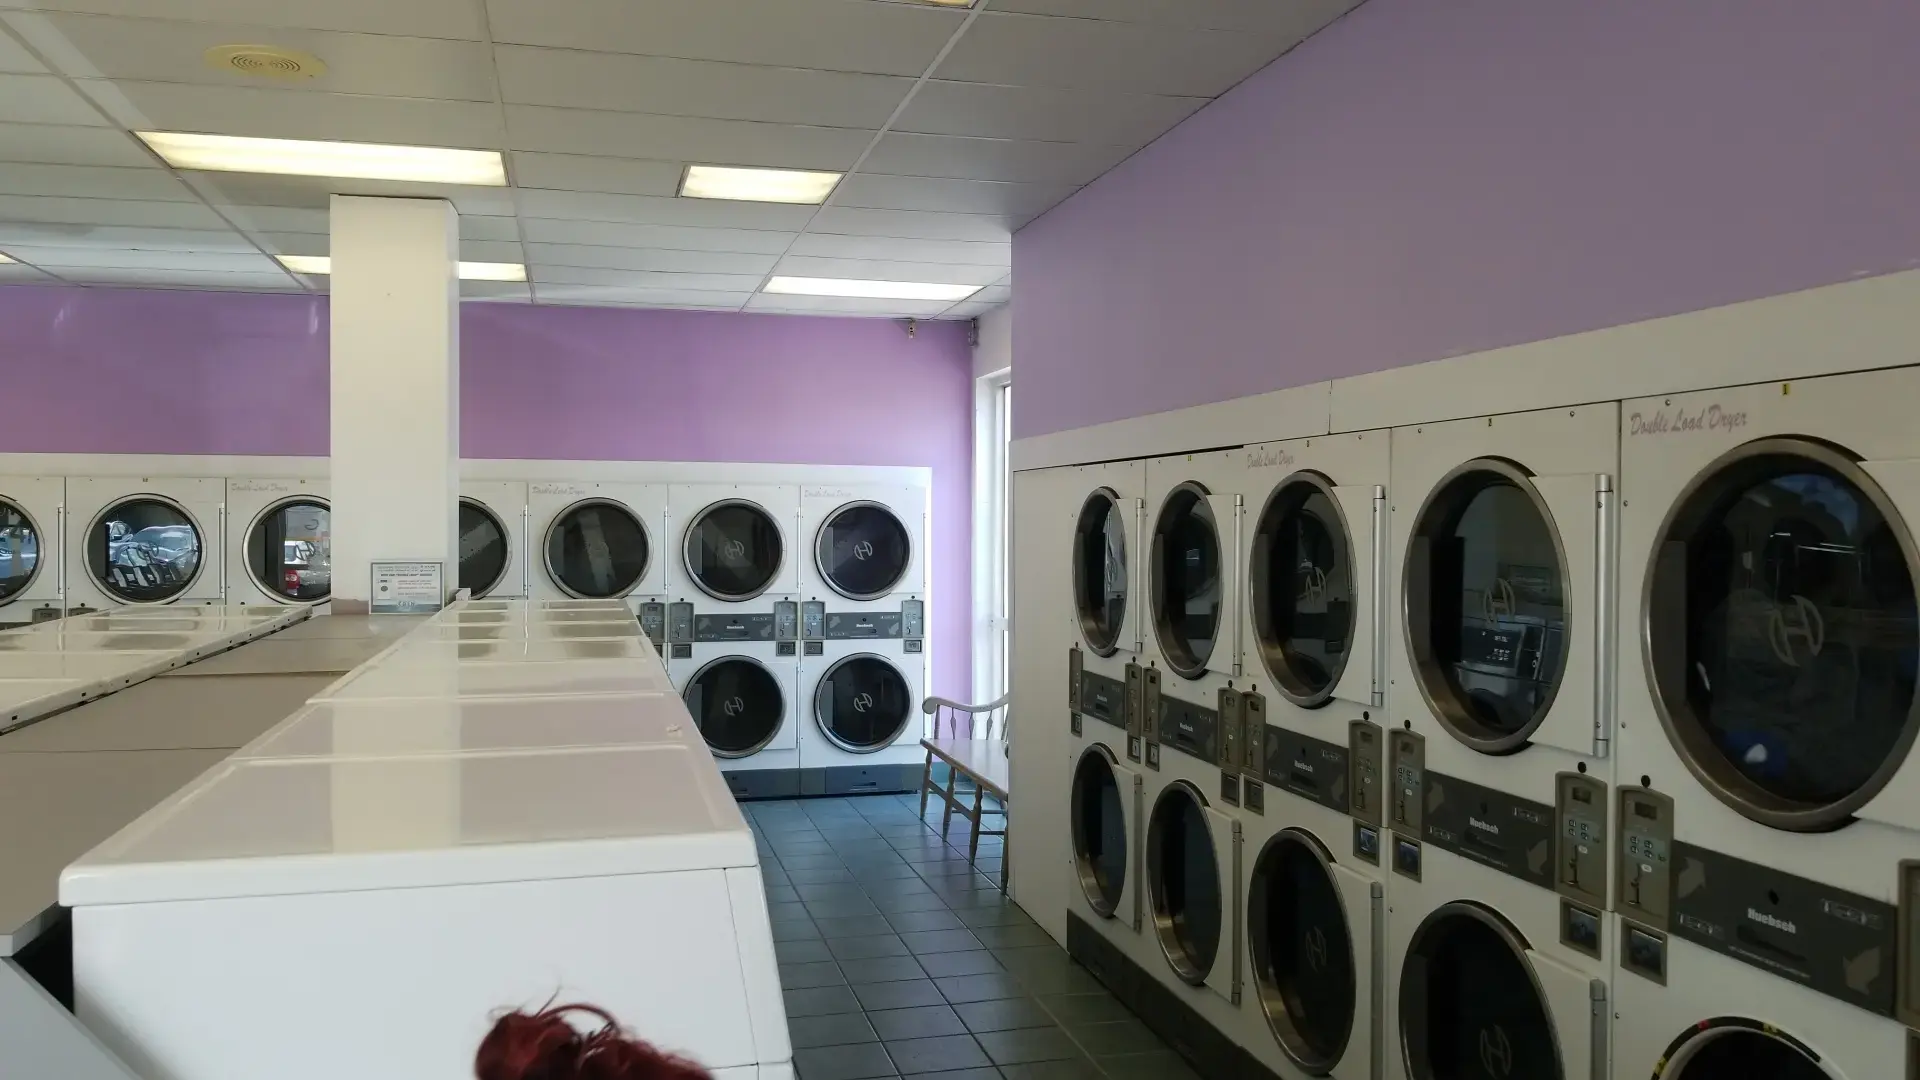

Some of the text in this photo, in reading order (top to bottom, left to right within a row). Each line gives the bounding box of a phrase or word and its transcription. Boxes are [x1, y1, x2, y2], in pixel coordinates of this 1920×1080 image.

[1630, 403, 1748, 436] Double Load Dryer
[1747, 907, 1797, 934] Huebsch
